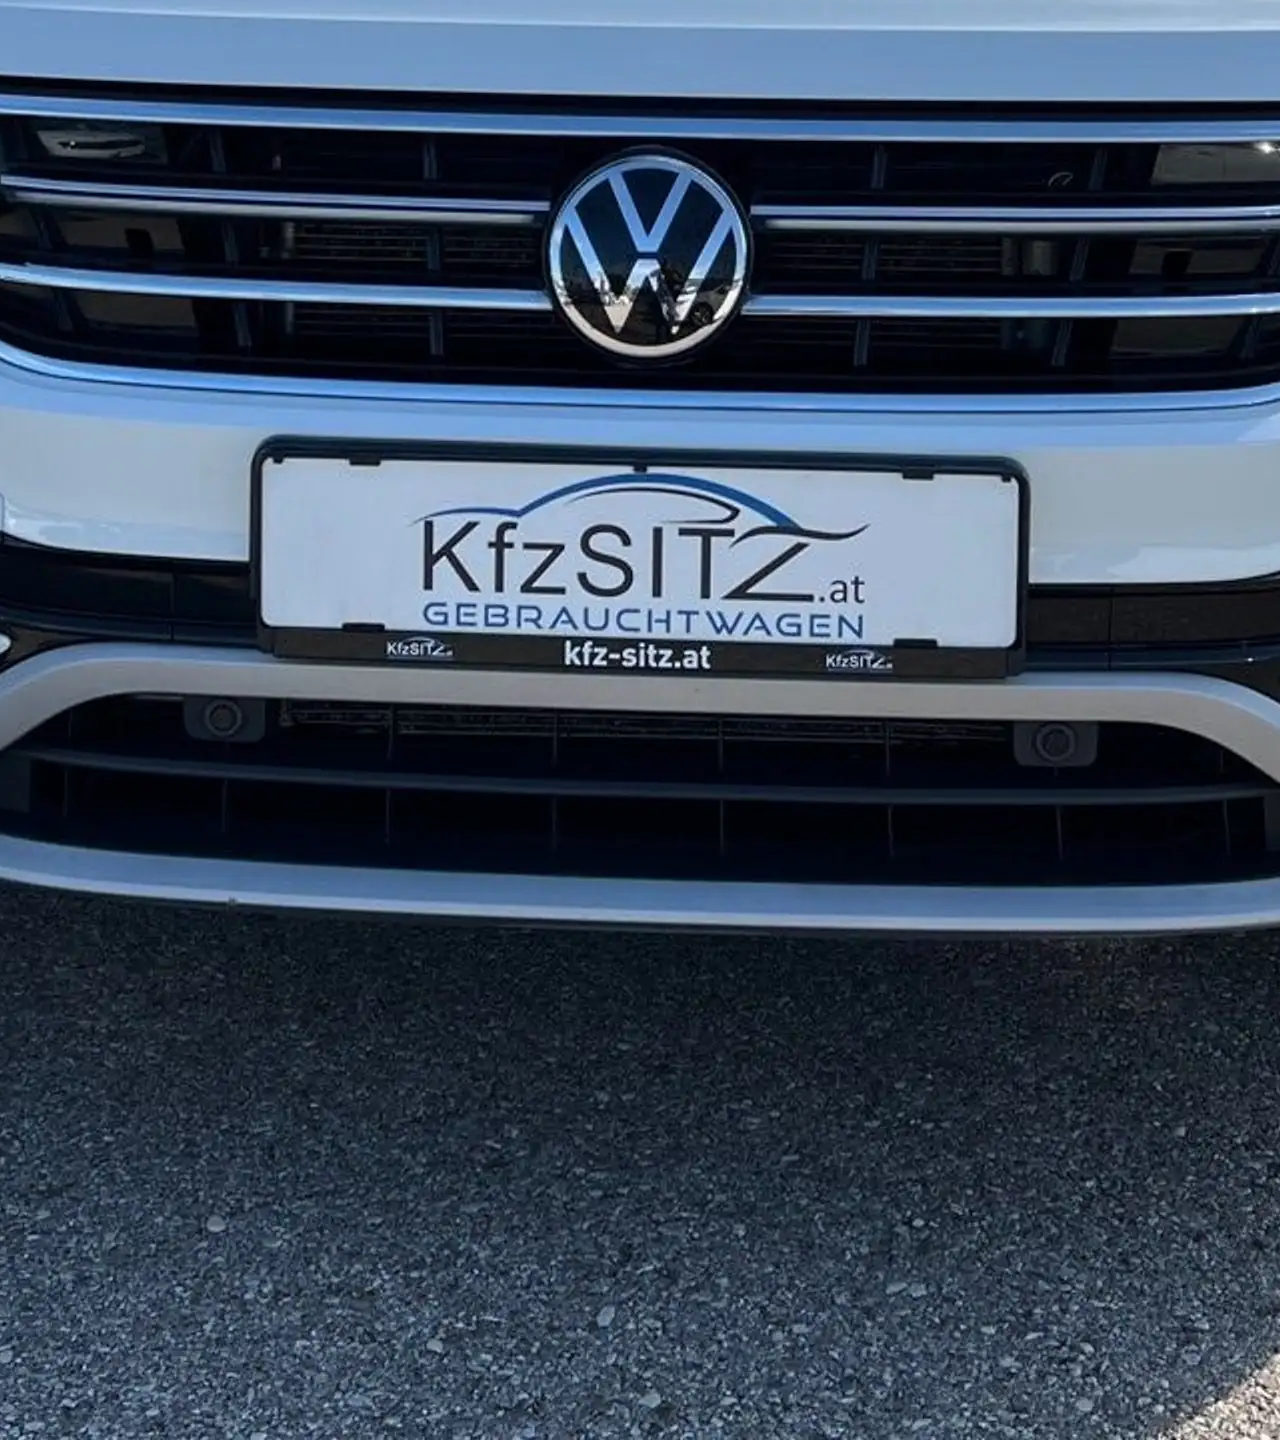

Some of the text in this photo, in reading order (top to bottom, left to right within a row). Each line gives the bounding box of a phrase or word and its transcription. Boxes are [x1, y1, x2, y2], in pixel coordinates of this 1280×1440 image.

[421, 519, 867, 604] KfzSITZ.at
[423, 601, 865, 640] GEBRAUCHTWAGEN
[564, 640, 712, 670] kfz-sitz.at
